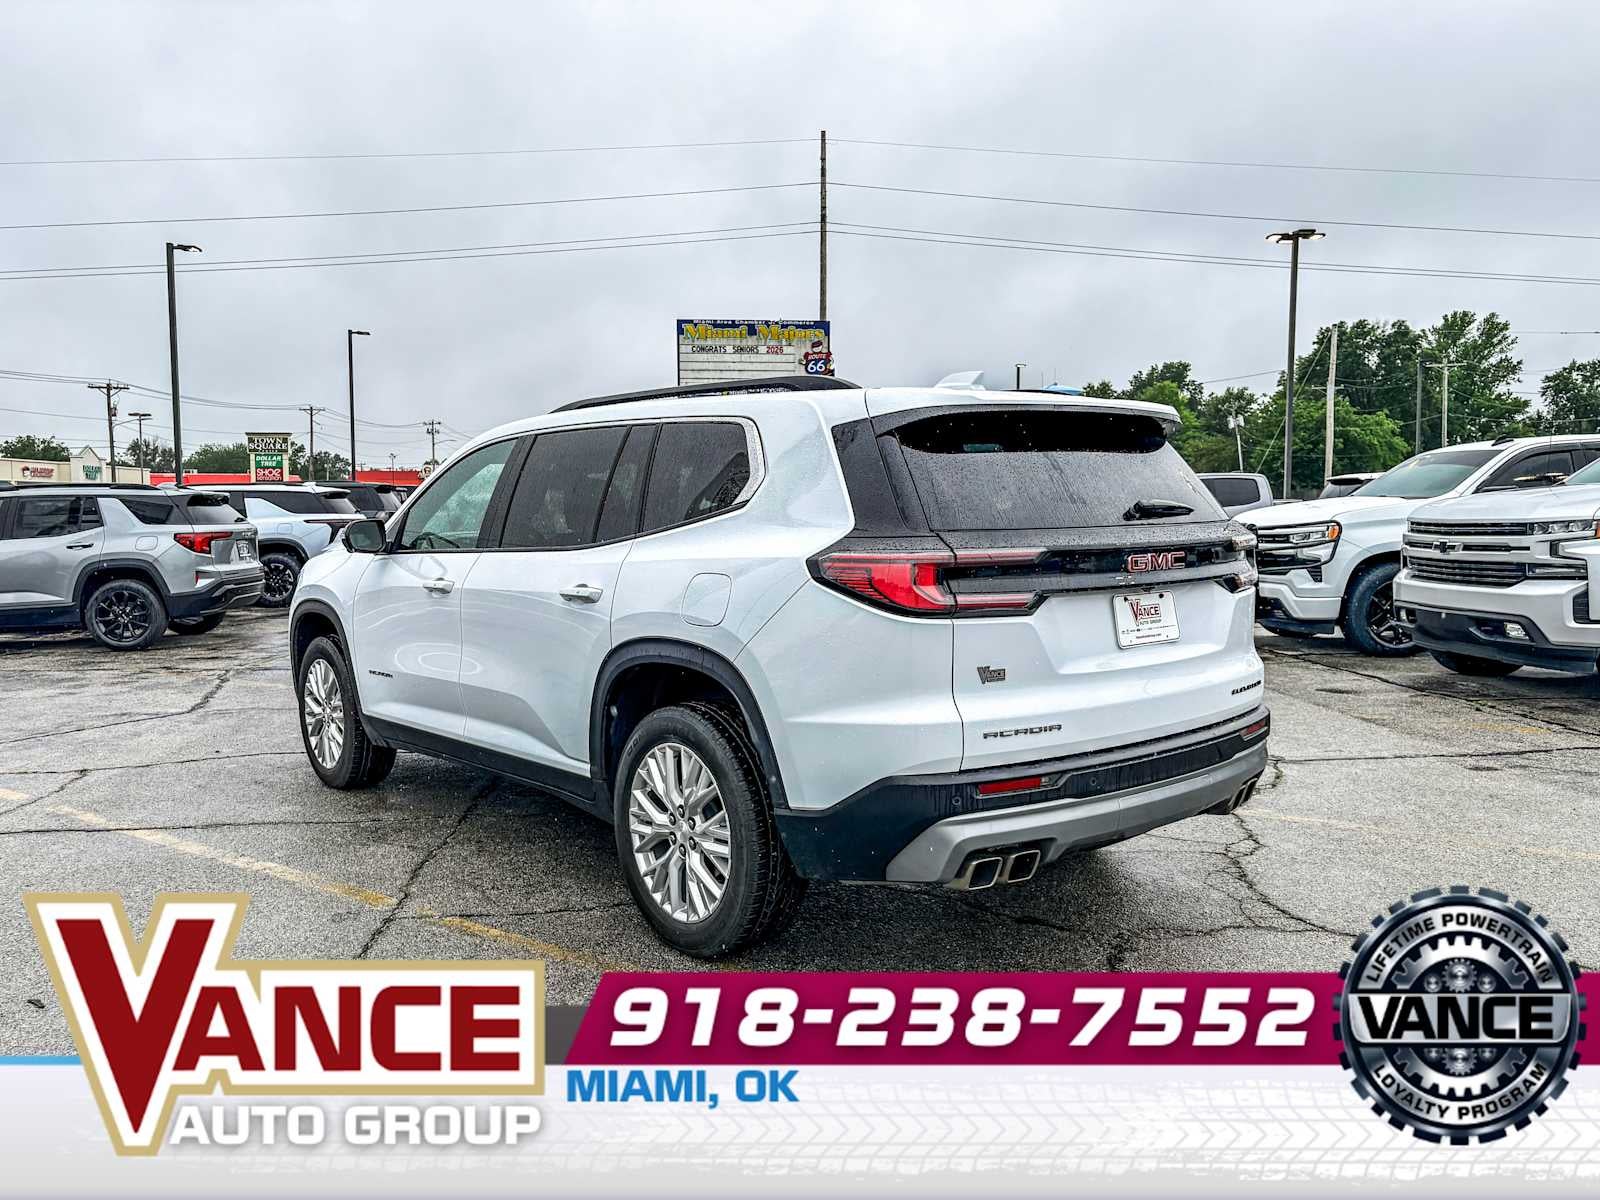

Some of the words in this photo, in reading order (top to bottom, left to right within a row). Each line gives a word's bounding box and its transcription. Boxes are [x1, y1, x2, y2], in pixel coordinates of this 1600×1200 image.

[683, 323, 747, 341] Miami
[756, 324, 825, 342] Majors
[691, 345, 727, 354] CONGRATS
[732, 345, 760, 354] SENIORS
[766, 345, 784, 355] 2026
[807, 360, 826, 372] 66
[1128, 551, 1185, 573] GMC
[983, 724, 1062, 739] ACADIA
